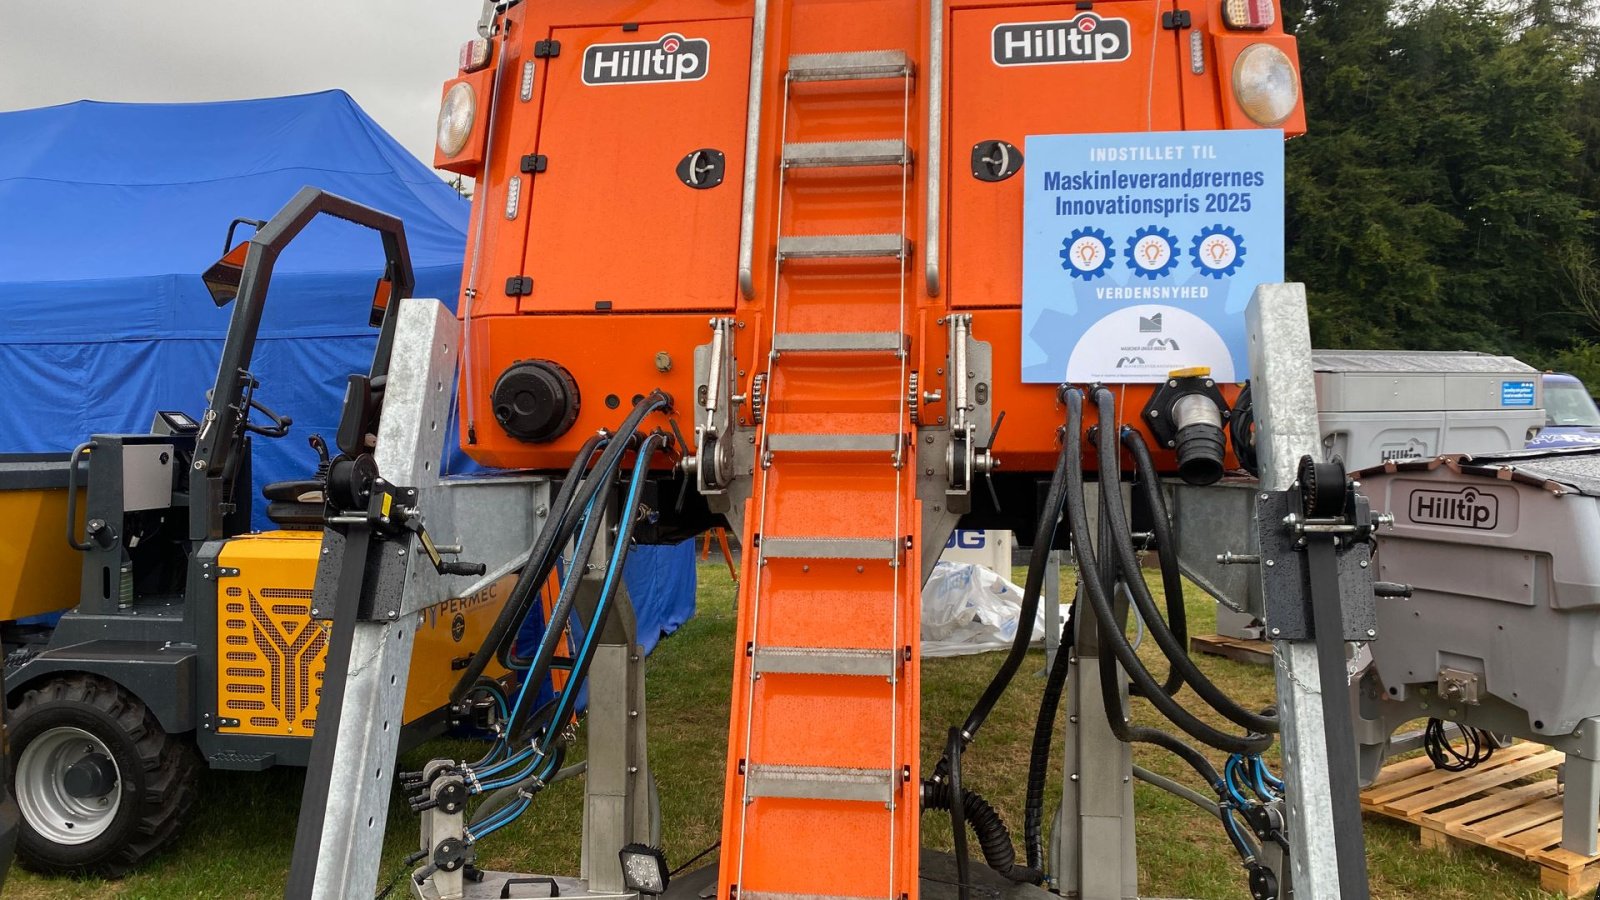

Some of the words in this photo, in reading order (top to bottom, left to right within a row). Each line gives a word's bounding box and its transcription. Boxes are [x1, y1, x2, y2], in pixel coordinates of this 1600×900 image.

[1005, 18, 1120, 60] Hilltip
[593, 38, 699, 80] Hilltip
[1090, 147, 1185, 162] INDSTILLET
[1192, 145, 1217, 160] TIL
[1044, 168, 1264, 191] Maskinleverandørernes
[1055, 194, 1200, 217] Innovationspris
[1205, 192, 1251, 213] 2025
[1096, 286, 1209, 300] VERDENSNYHED
[1417, 492, 1490, 528] Hilltip
